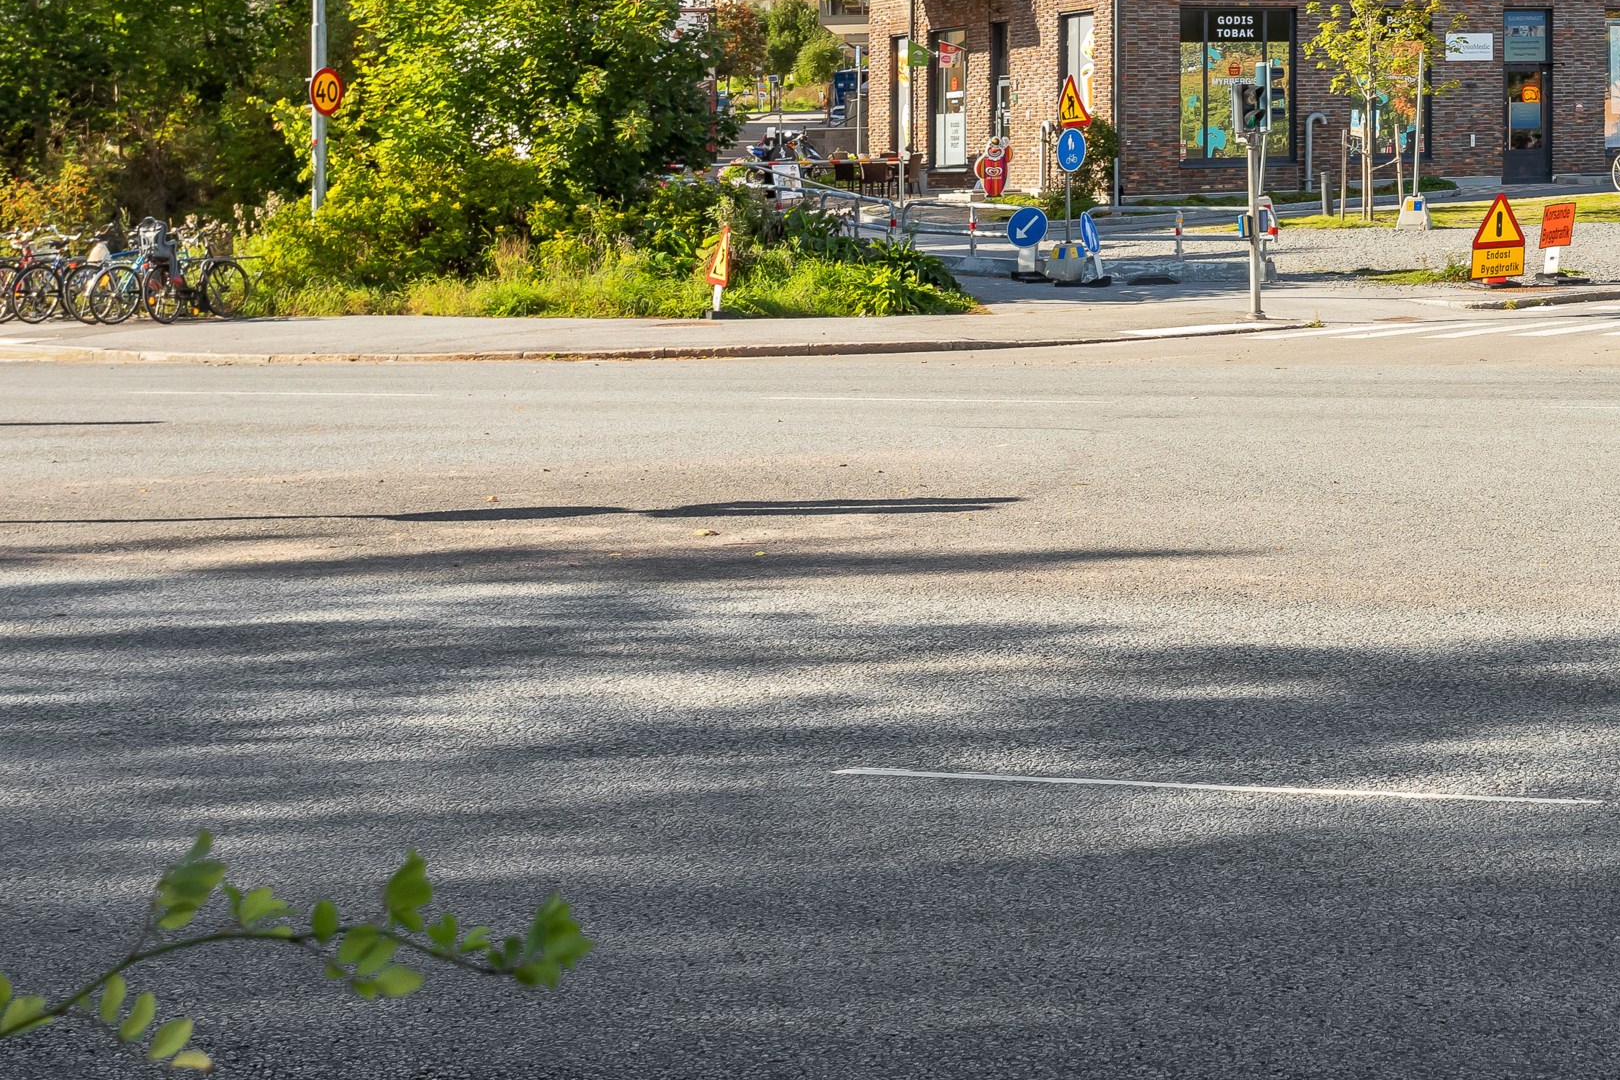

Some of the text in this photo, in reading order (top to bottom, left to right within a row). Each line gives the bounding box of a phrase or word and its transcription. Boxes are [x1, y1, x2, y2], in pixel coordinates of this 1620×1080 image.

[1217, 16, 1254, 25] GODIS
[1216, 28, 1255, 38] TOBAK
[316, 80, 339, 103] 40
[1545, 208, 1571, 221] Korsande
[1541, 226, 1570, 244] Byggtrafik
[1486, 250, 1511, 260] Endast
[1480, 263, 1520, 275] Byggtrafik
